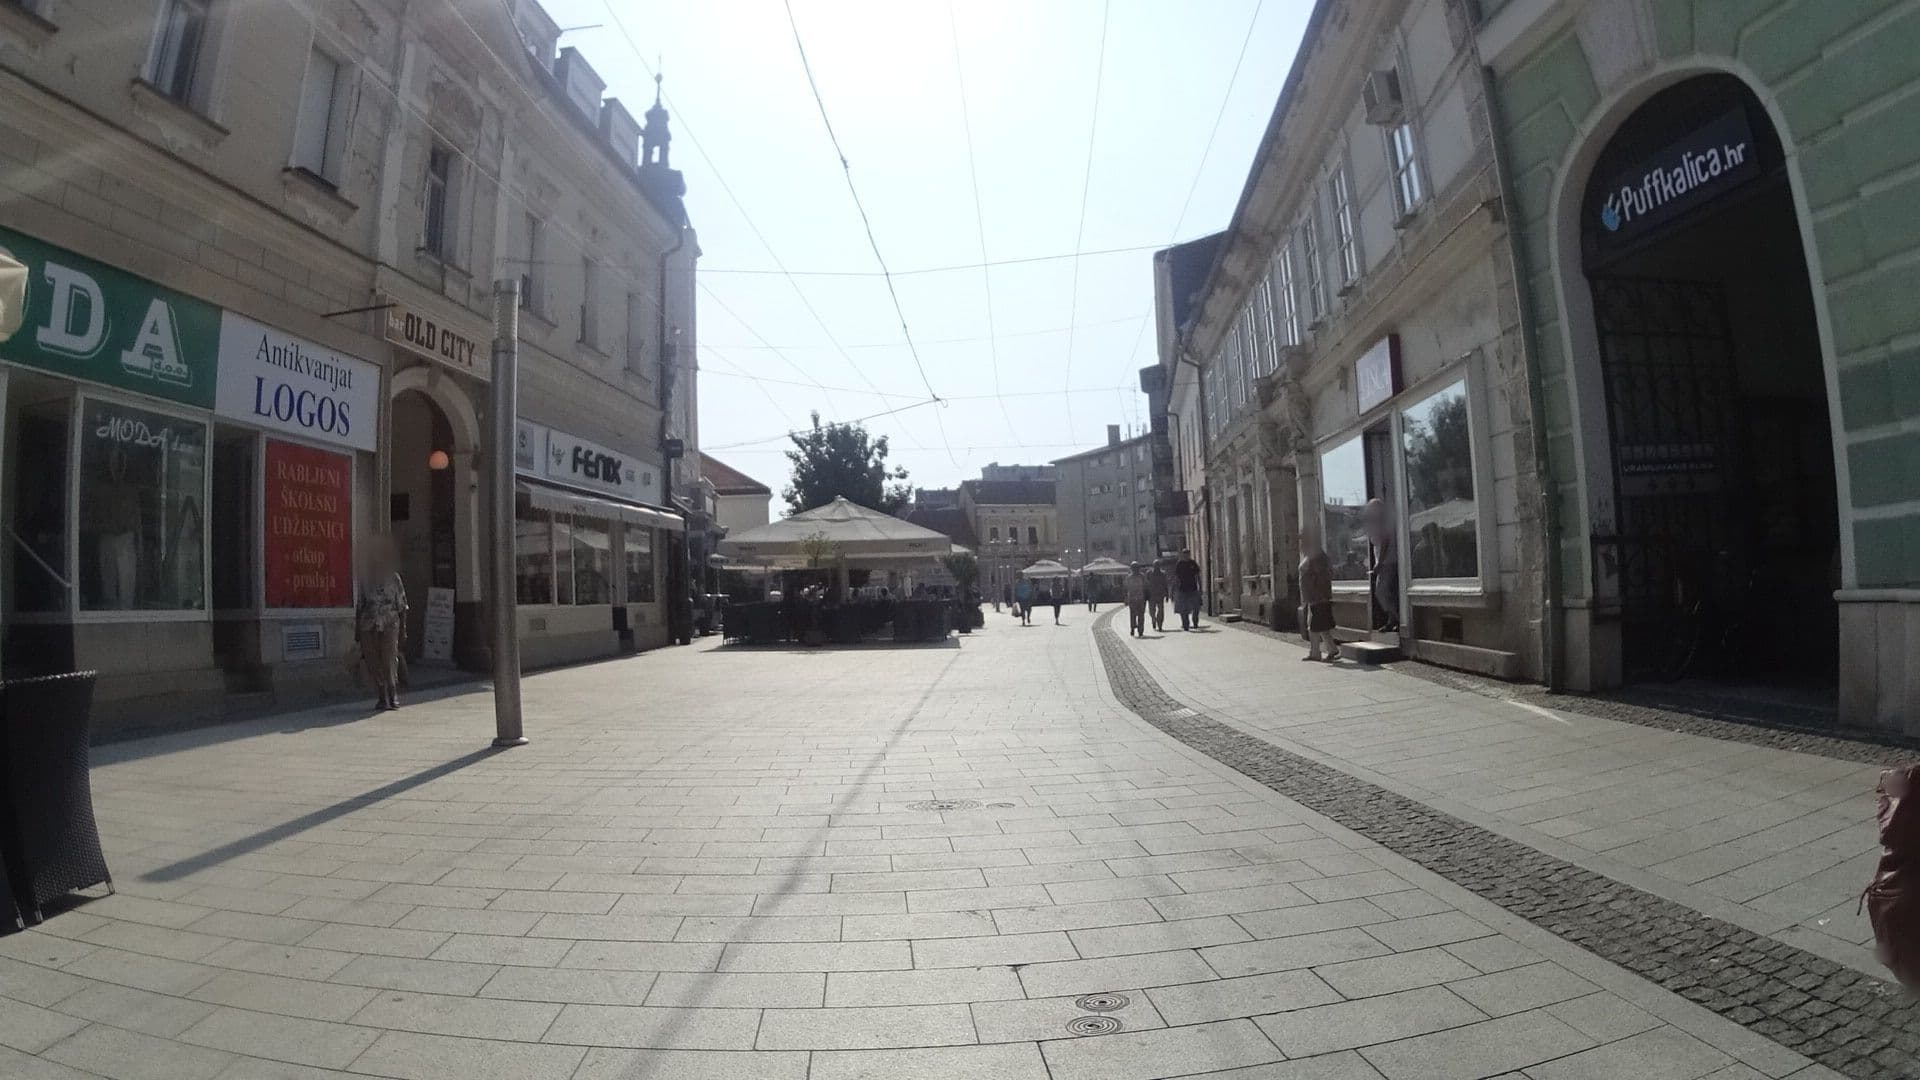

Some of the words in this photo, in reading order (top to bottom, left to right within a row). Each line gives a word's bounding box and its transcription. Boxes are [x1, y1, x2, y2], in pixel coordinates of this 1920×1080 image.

[1621, 143, 1746, 221] Puffkalica.hr
[405, 312, 436, 350] OLD
[441, 329, 475, 367] CITY
[256, 334, 353, 392] Antikvarijat
[255, 376, 351, 437] LOGOS
[277, 460, 341, 489] RABLJENI
[281, 486, 337, 513] ŠKOLSKI
[273, 514, 345, 541] UDŽBENICI
[293, 548, 325, 568] otkup
[293, 571, 336, 593] prodaja
